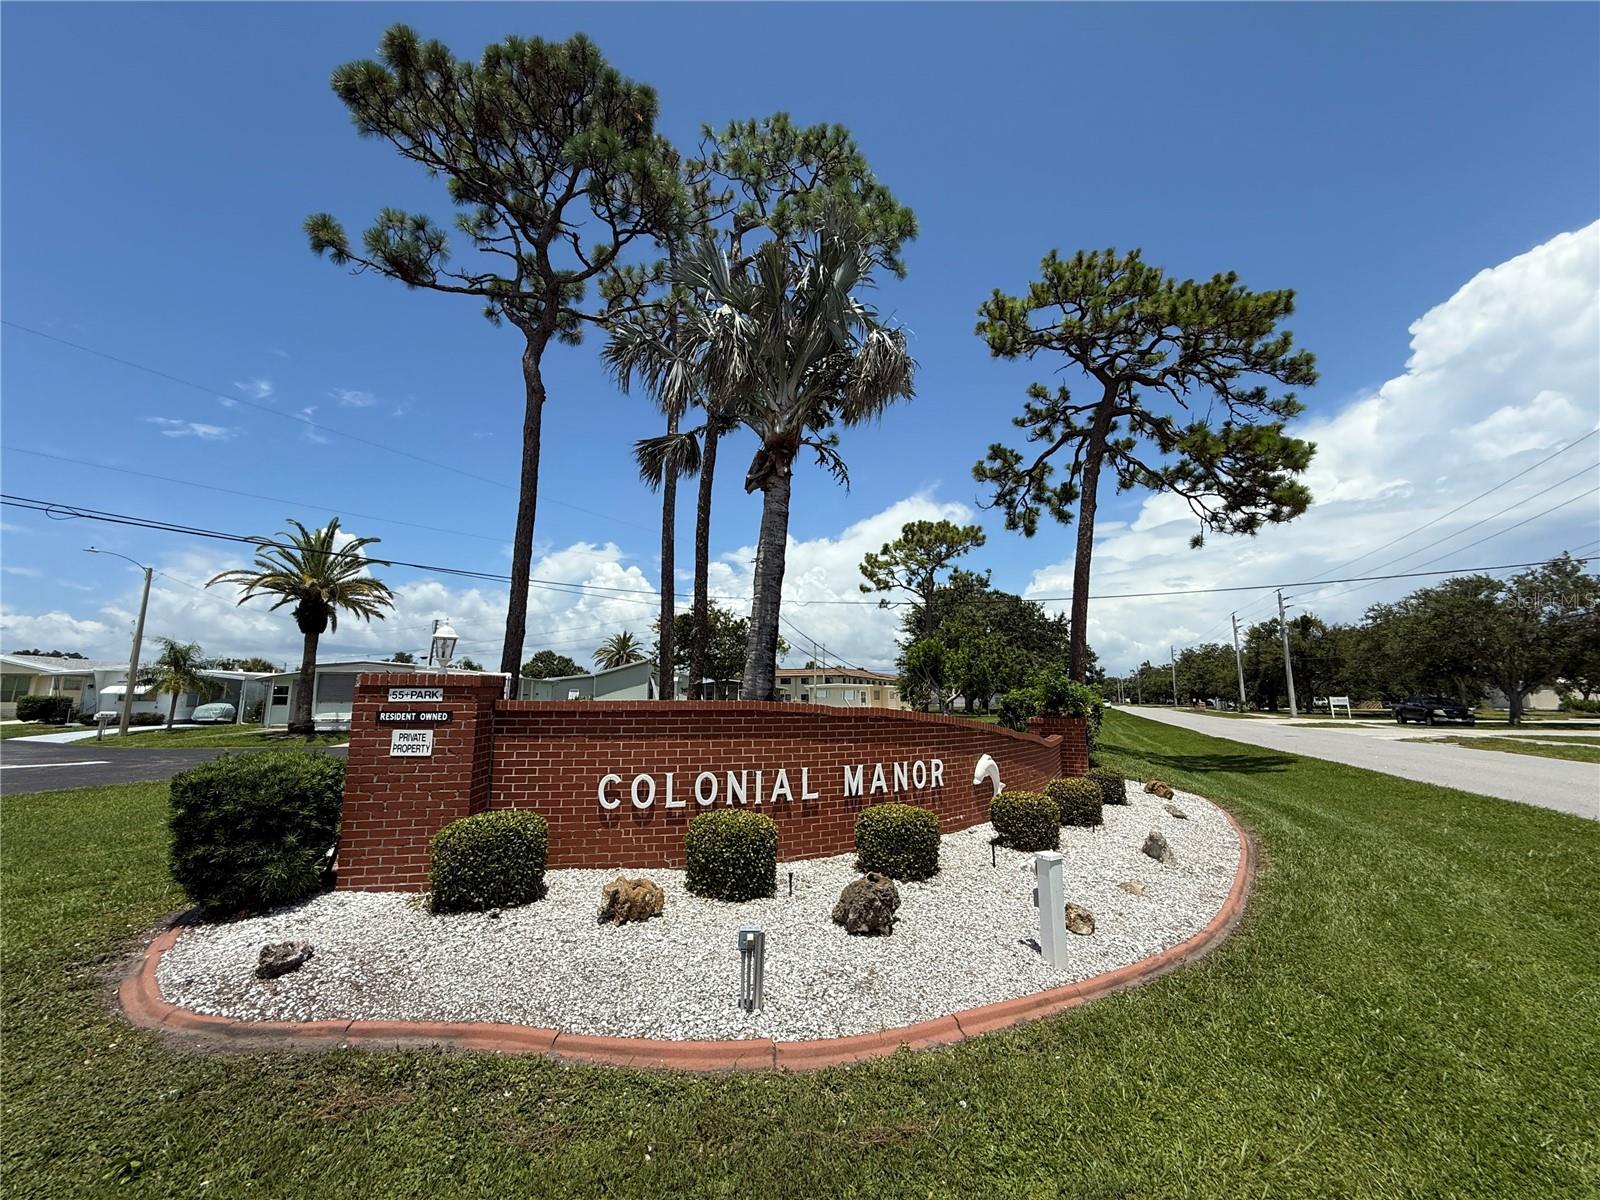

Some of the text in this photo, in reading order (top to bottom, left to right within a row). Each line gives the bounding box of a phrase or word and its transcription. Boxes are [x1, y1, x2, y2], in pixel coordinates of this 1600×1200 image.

[380, 712, 448, 720] RESIDENT OWNED
[398, 733, 427, 742] PRIVATE
[392, 744, 430, 753] PROPERTY
[597, 758, 945, 811] COLONIAL MANOR
